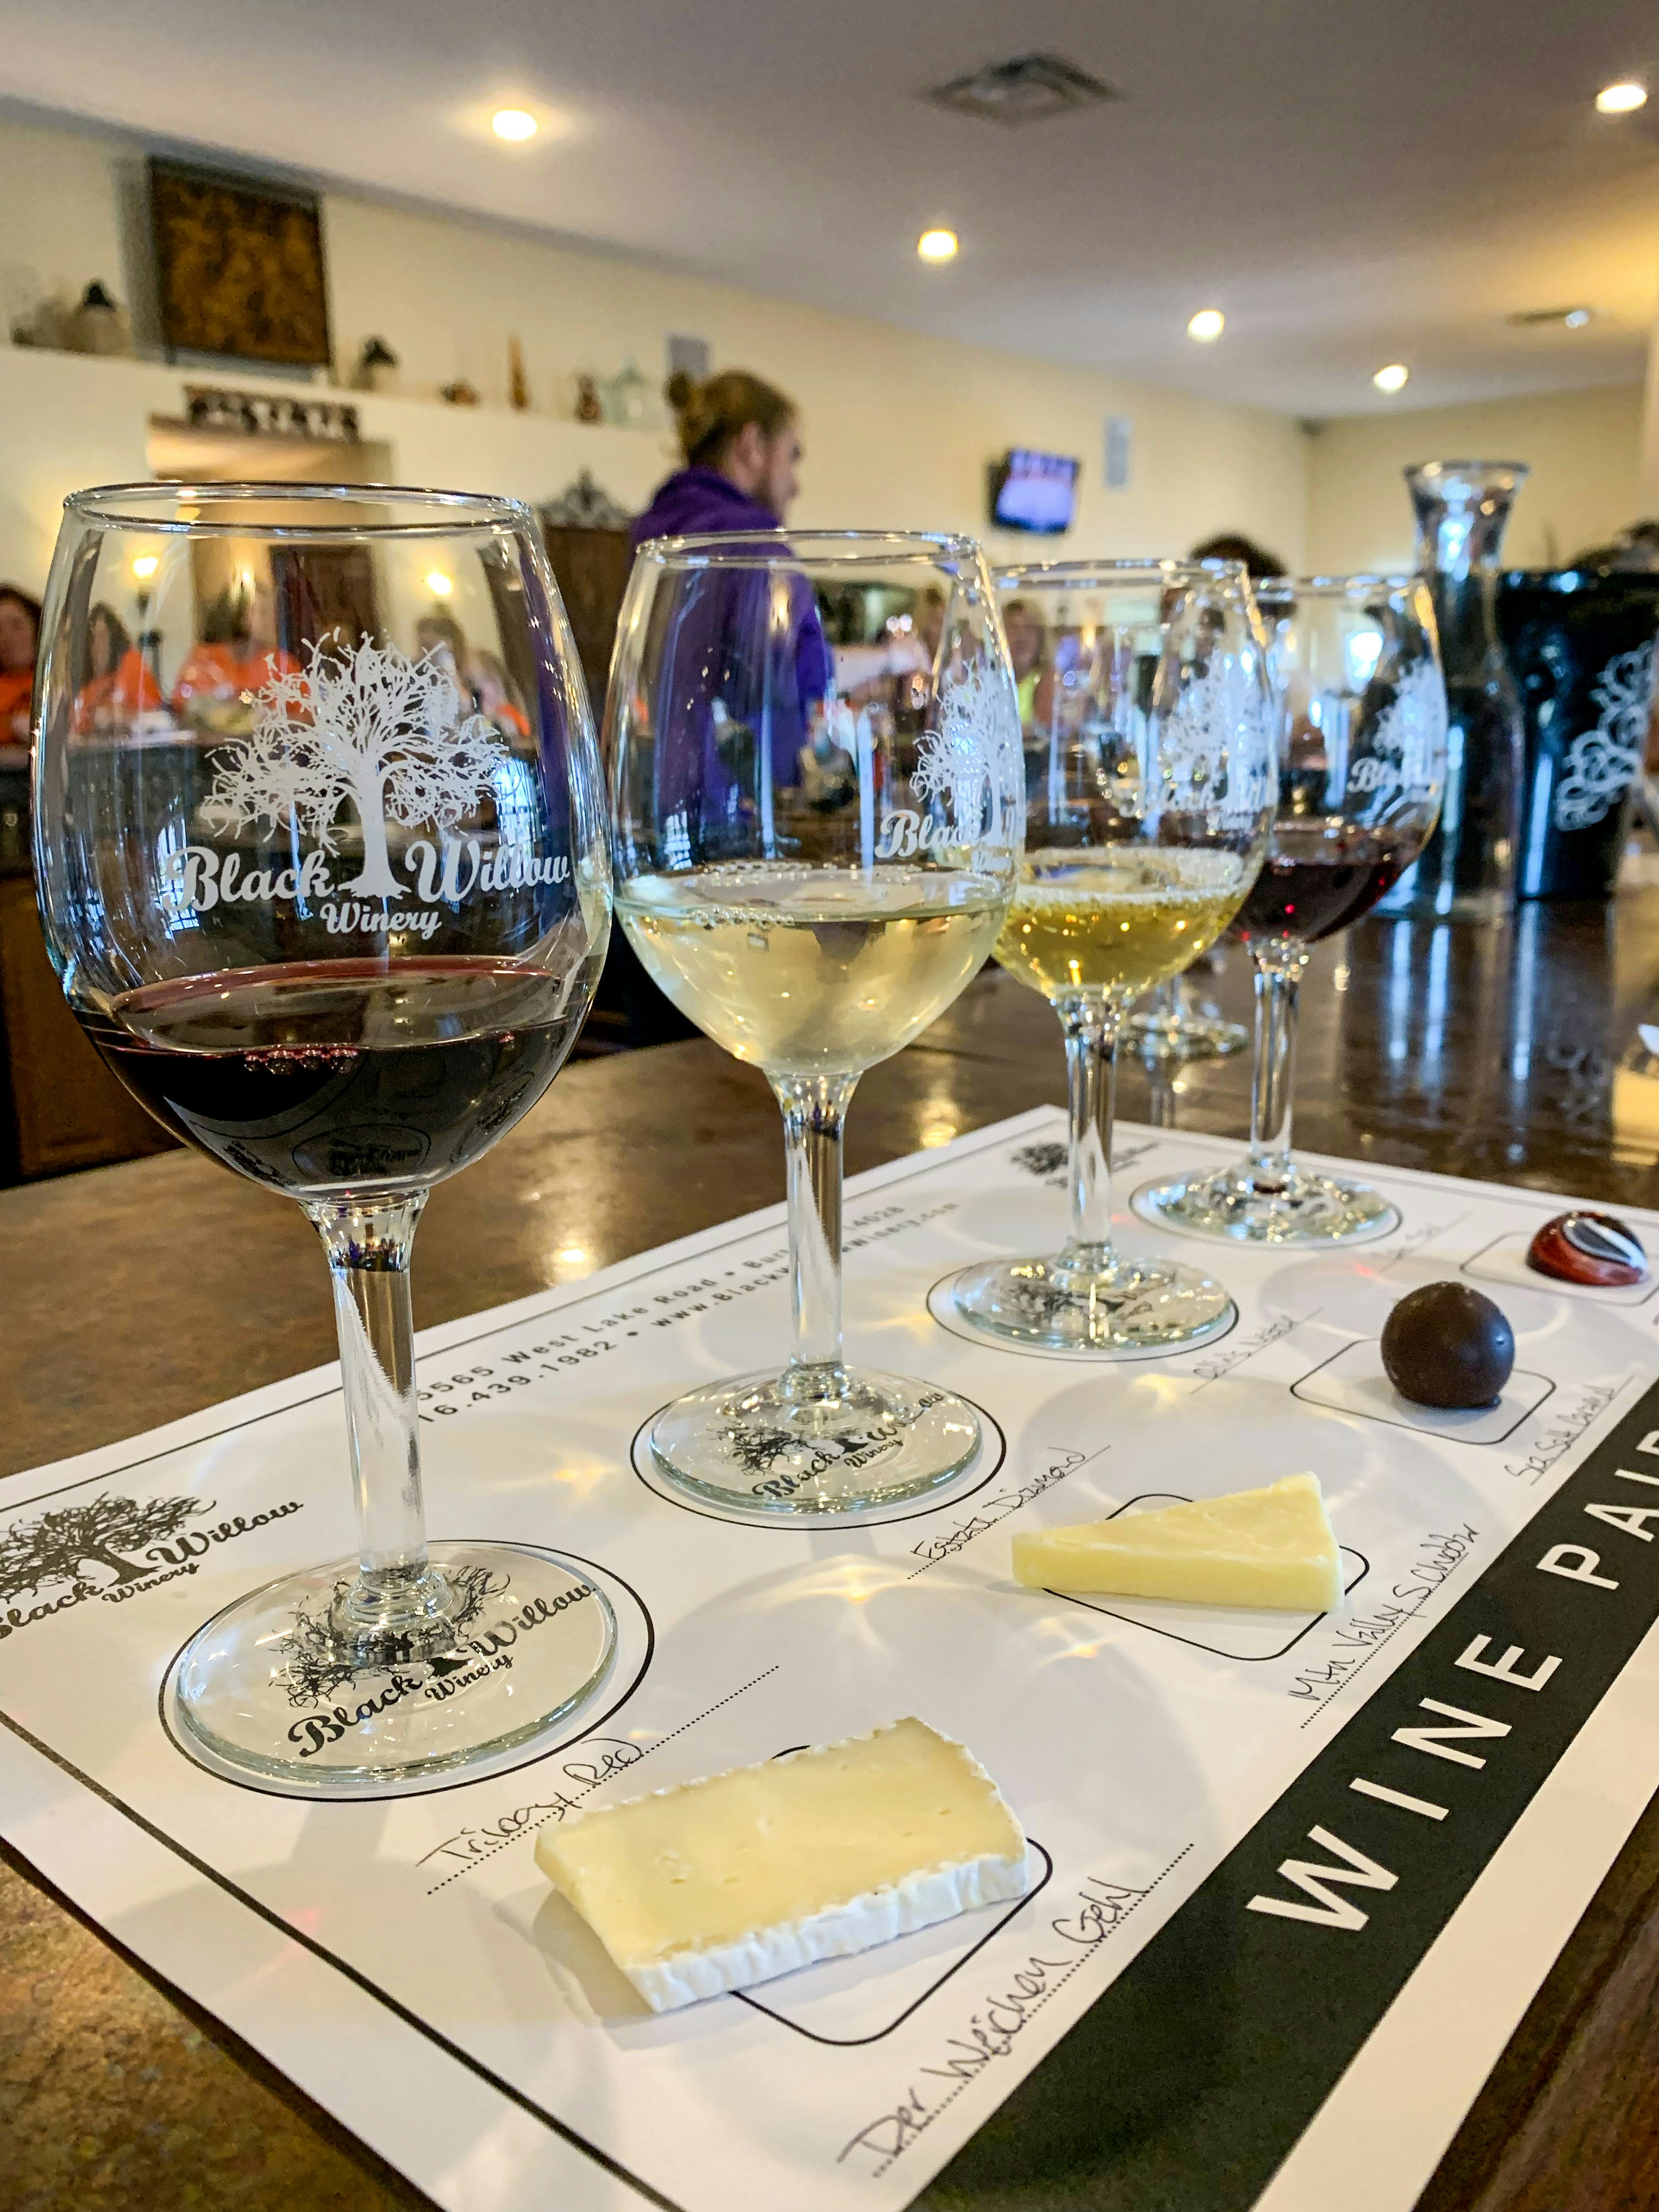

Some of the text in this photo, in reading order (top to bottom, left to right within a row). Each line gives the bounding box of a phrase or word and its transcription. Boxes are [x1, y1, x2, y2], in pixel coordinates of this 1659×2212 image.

[162, 839, 571, 912] Black Willow
[319, 902, 442, 940] Winery
[416, 1366, 494, 1401] 5565
[500, 1333, 579, 1364] West
[582, 1306, 649, 1333] Lake
[653, 1278, 719, 1305] Road
[417, 1340, 619, 1423] 16.439.1982
[752, 1451, 841, 1498] Black
[843, 1438, 904, 1470] Winery
[145, 1500, 305, 1565] Willow
[101, 1561, 200, 1603] Winery
[286, 1583, 597, 1758] Black Willow
[424, 1651, 515, 1702] Winery
[562, 1737, 645, 1786] Red
[1246, 1633, 1564, 1932] WINE
[837, 2086, 928, 2158] Der
